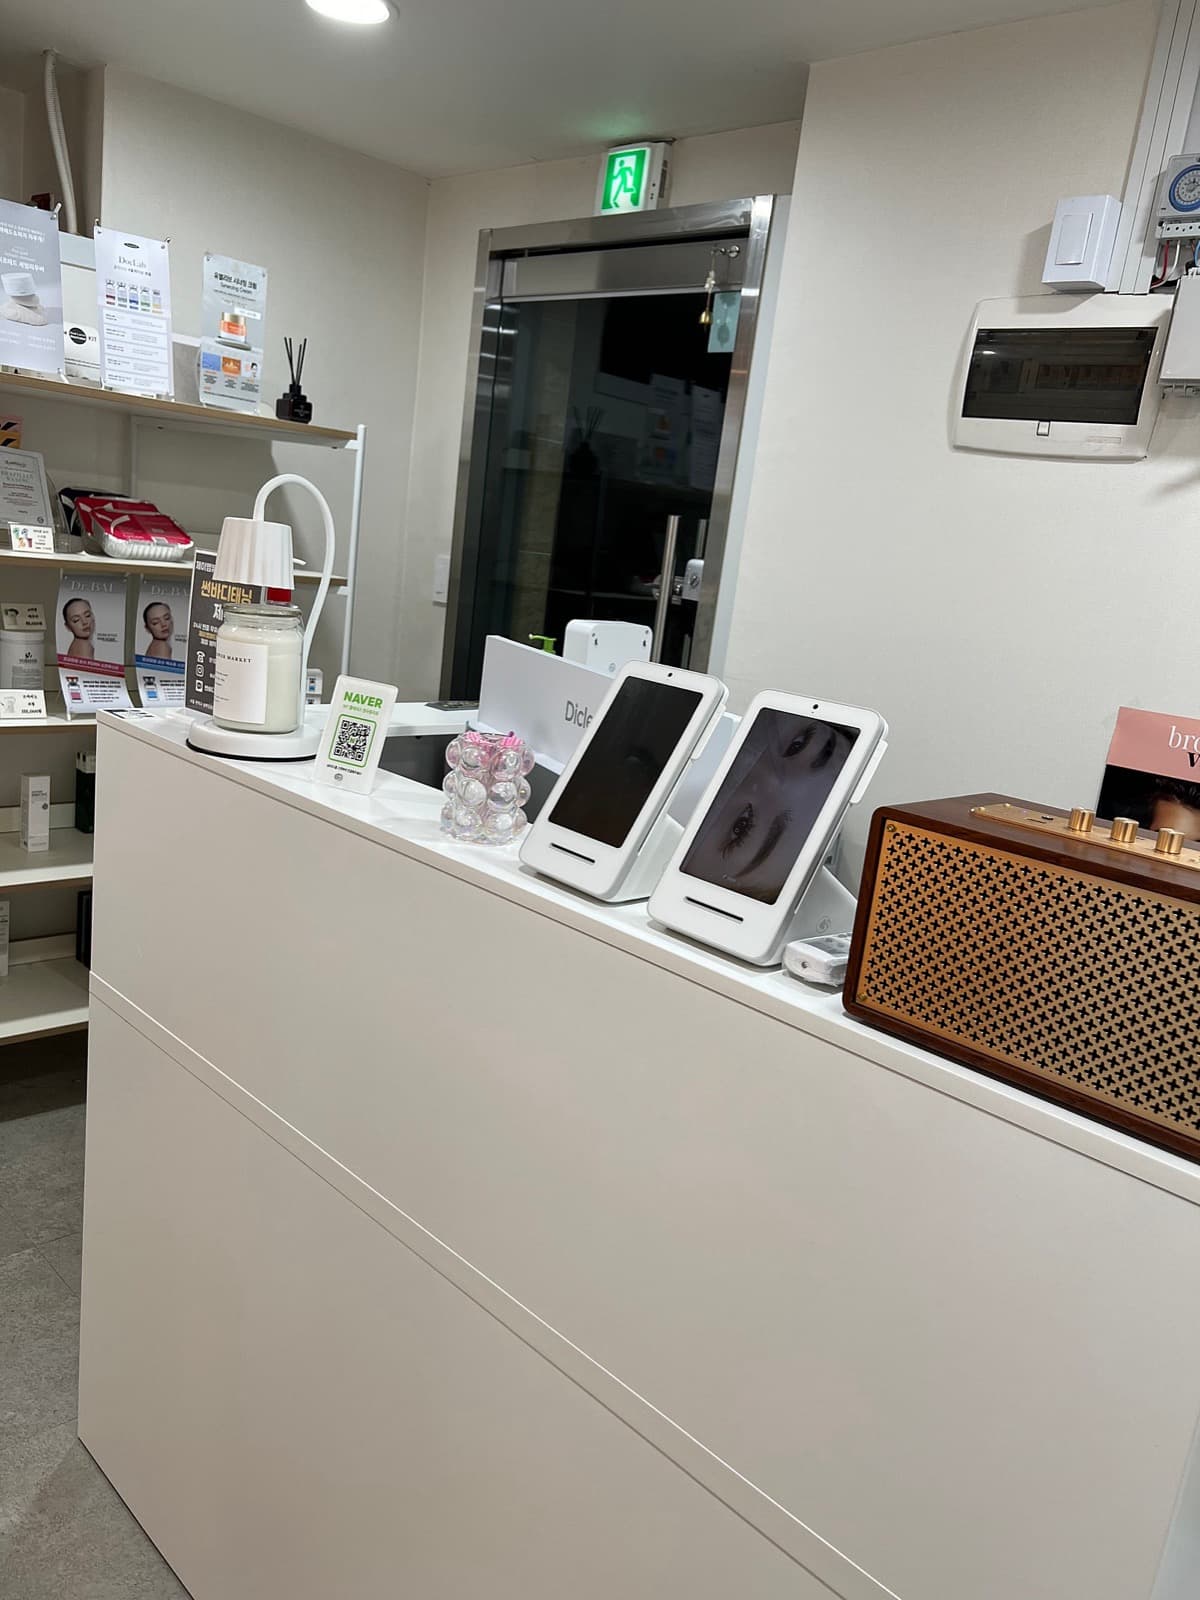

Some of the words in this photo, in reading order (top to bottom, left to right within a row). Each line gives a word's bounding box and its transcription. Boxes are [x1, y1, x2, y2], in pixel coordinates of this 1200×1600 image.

[201, 580, 253, 605] 썬바디태닝
[227, 654, 252, 663] MARKET
[343, 691, 383, 709] NAVER
